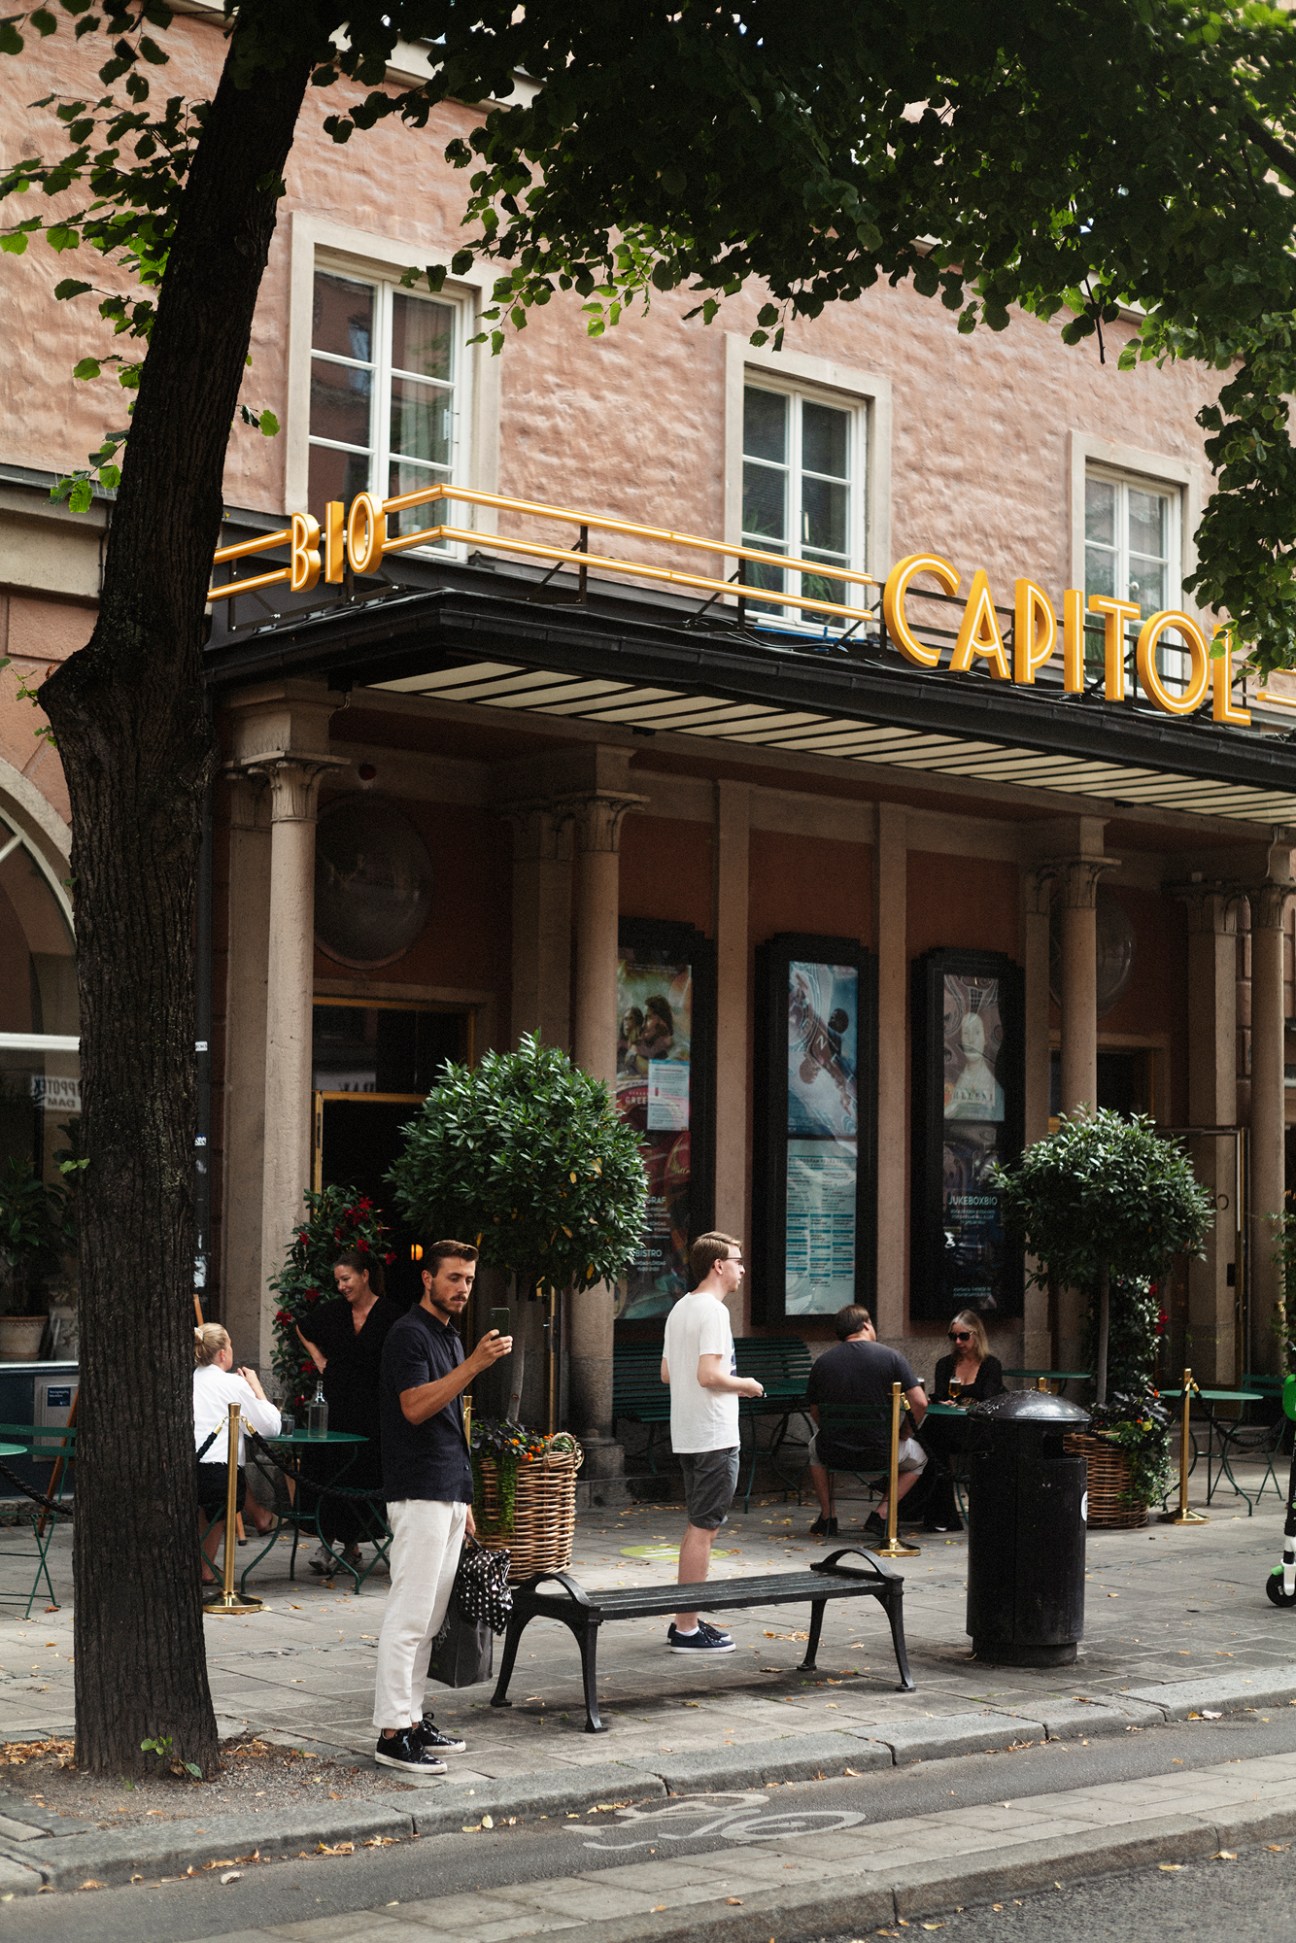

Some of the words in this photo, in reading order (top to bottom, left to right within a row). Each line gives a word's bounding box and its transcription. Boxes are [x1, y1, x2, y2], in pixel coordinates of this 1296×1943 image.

[290, 491, 386, 593] BIO
[883, 552, 1251, 727] CAPITOL
[948, 1195, 998, 1206] JUKEBOXBIO
[635, 1248, 663, 1258] BISTRO
